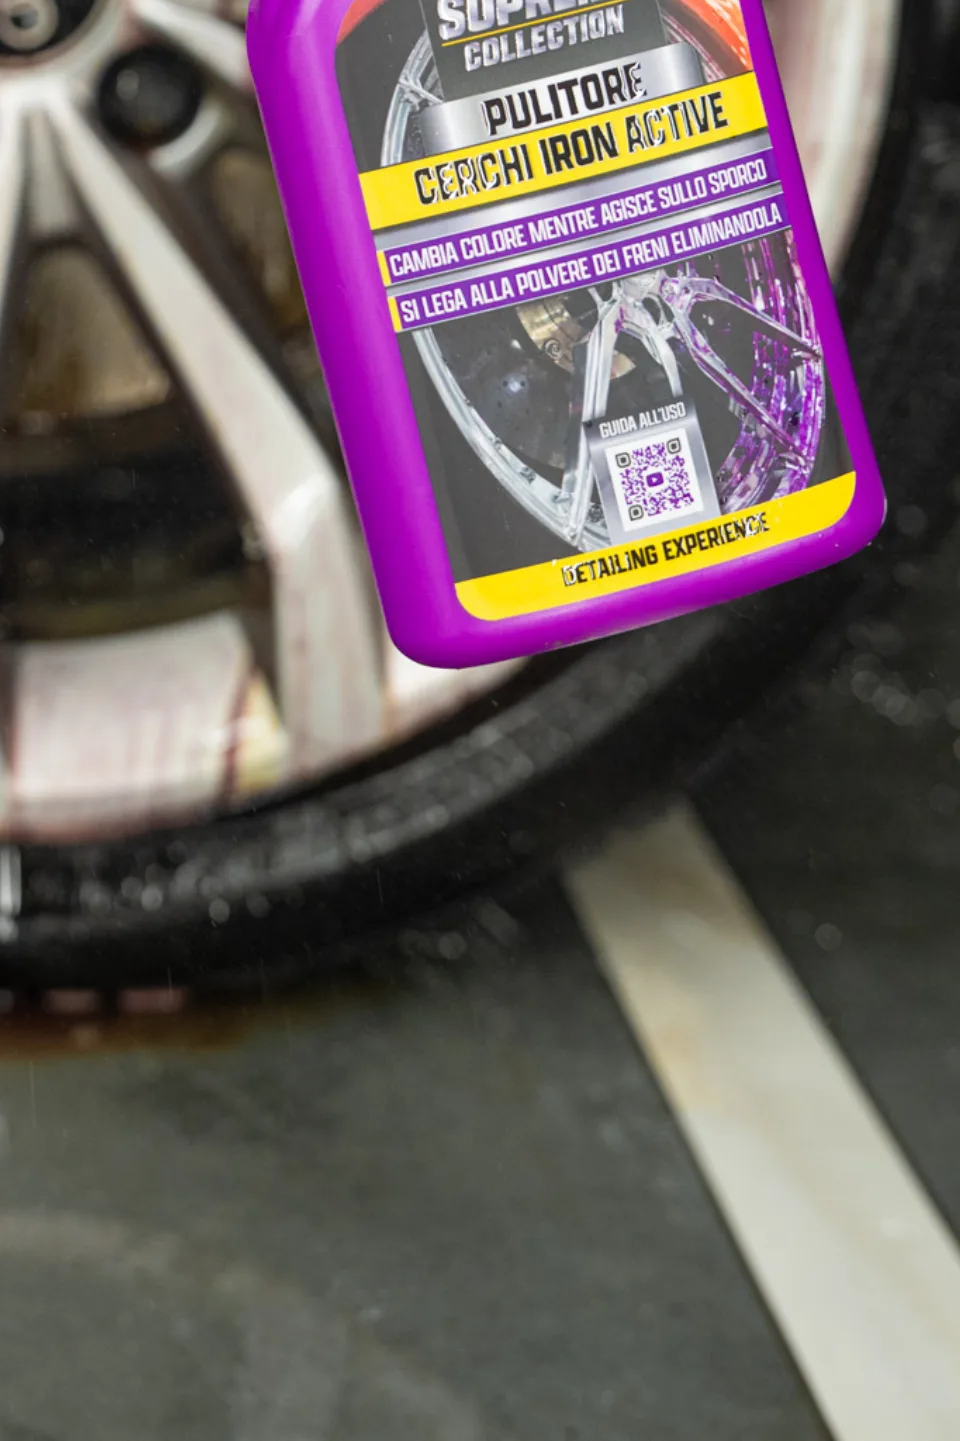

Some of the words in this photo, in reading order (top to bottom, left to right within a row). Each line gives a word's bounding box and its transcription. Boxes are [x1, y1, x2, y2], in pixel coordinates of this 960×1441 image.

[464, 4, 625, 72] COLLECTION
[482, 62, 647, 137] PULITORE
[414, 143, 535, 205] CERCHI
[539, 121, 619, 174] IRON
[624, 91, 728, 154] ACTIVE
[390, 242, 460, 277] CAMBIA
[460, 224, 528, 256] COLORE
[528, 206, 599, 244] MENTRE
[600, 191, 658, 226] AGISCE
[658, 176, 708, 209] SULLO
[708, 158, 768, 194] SPORCO
[400, 298, 421, 323] SI
[421, 288, 468, 318] LEGA
[470, 277, 515, 307] ALLA
[515, 256, 591, 295] POLVERE
[593, 248, 622, 276] DEI
[622, 235, 671, 268] FRENI
[670, 203, 783, 254] ELIMINANDOLA
[599, 415, 638, 439] GUIDA
[639, 401, 687, 428] ALL'USO
[561, 544, 659, 587] DETAILING
[662, 511, 770, 561] EXPERIENCE
